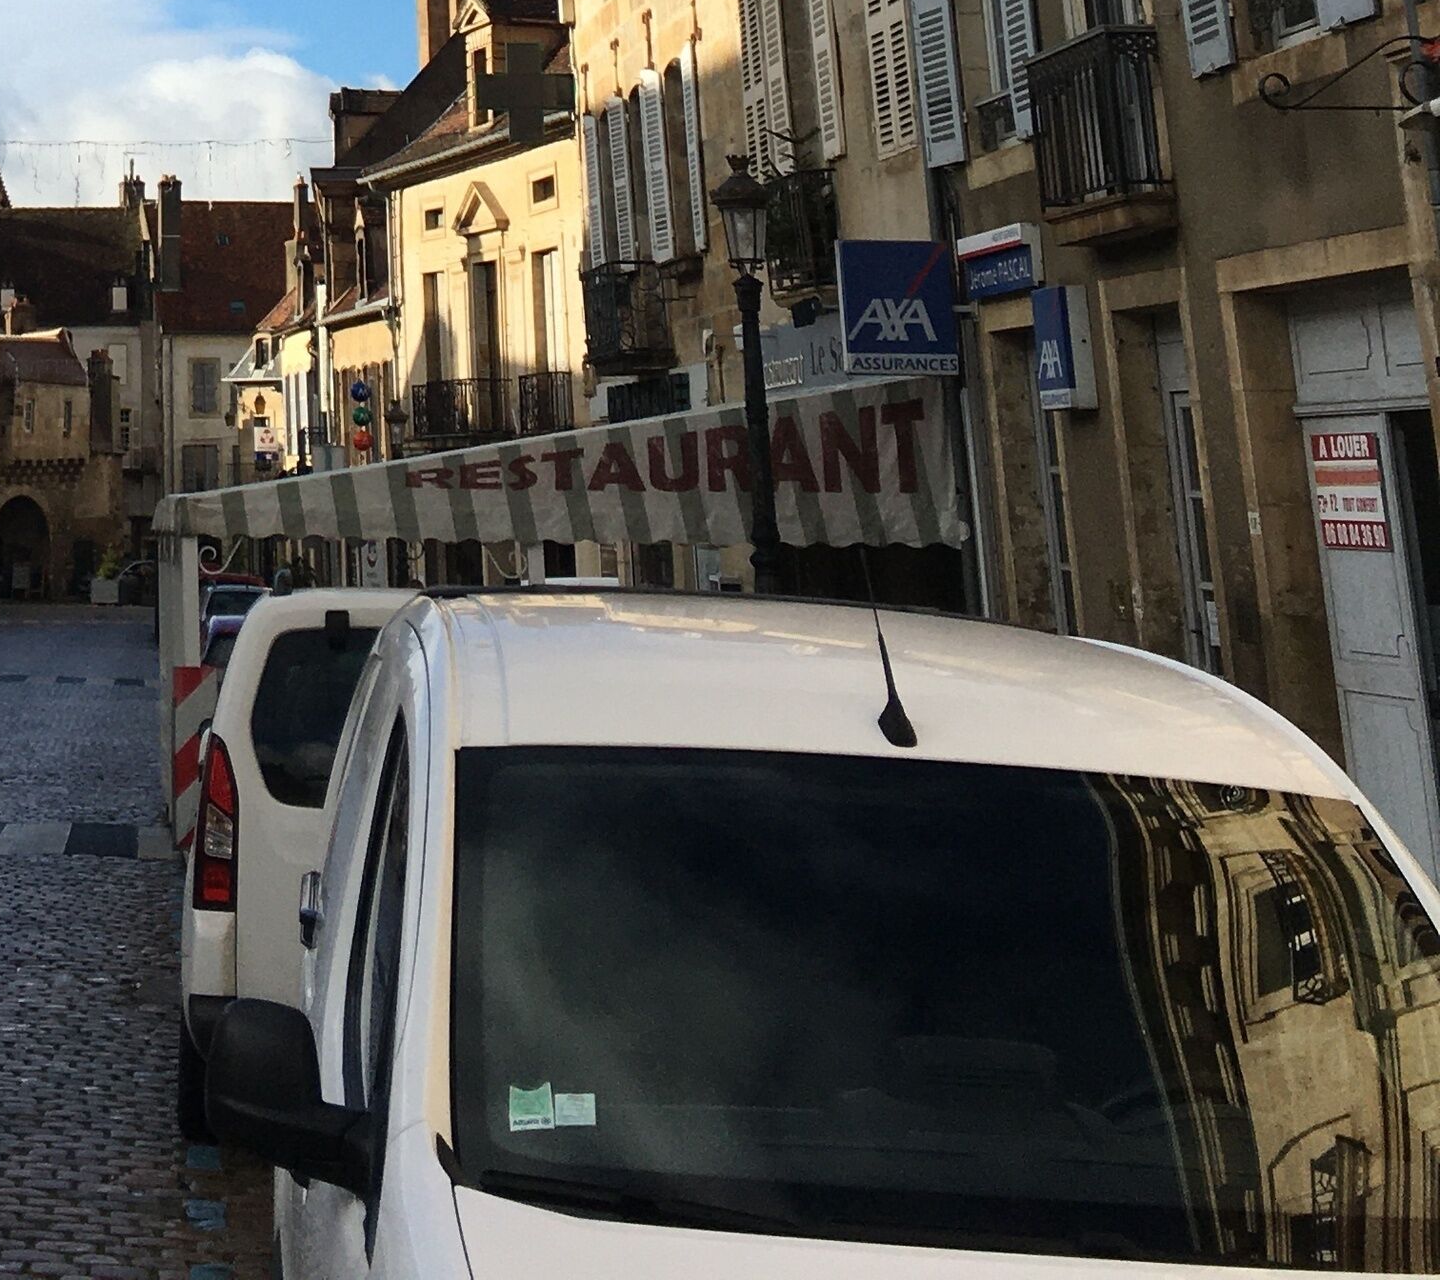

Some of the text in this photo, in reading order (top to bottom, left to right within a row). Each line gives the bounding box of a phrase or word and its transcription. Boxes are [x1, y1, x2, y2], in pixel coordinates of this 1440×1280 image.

[848, 297, 938, 341] AXA
[851, 356, 958, 373] ASSURANCES
[1038, 340, 1063, 380] AXA
[405, 398, 926, 494] RESTAURANT
[1319, 434, 1370, 458] A LOUER
